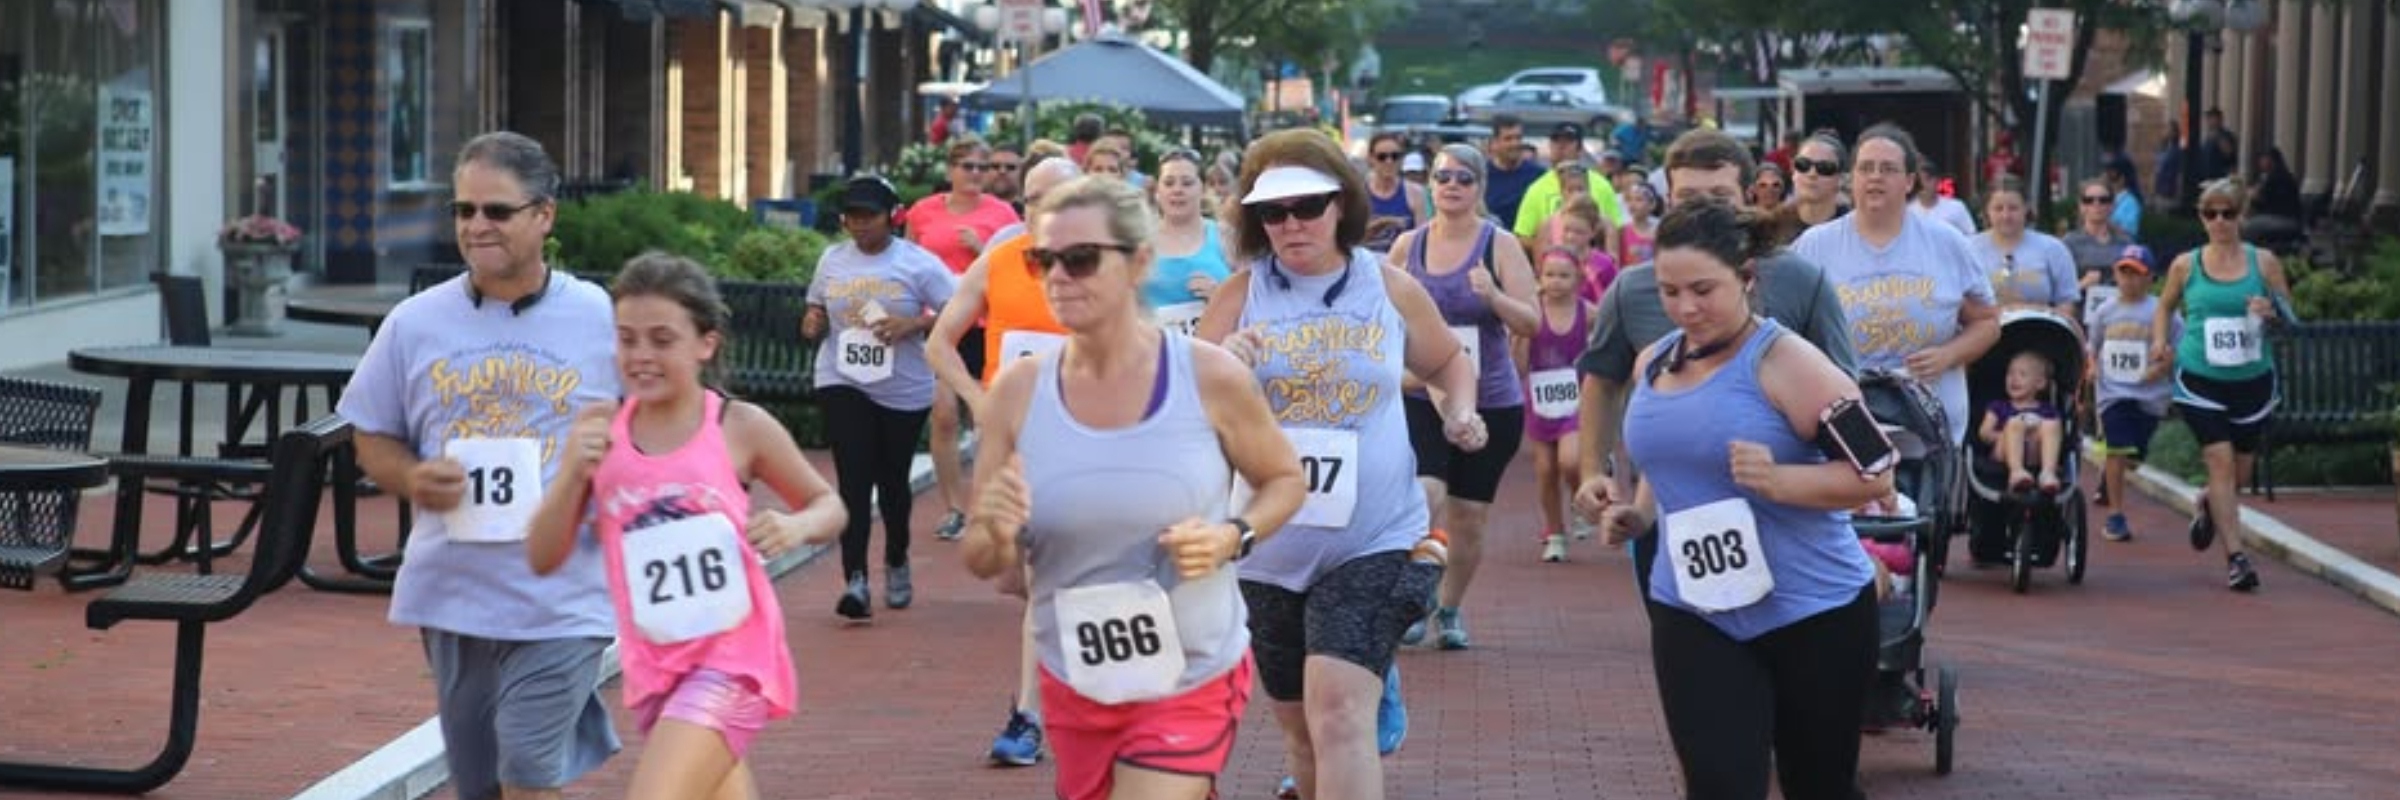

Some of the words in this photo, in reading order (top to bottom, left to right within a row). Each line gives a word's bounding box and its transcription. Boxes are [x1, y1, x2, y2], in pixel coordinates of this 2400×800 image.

[846, 343, 885, 368] 530
[1535, 382, 1577, 403] 1098
[468, 466, 515, 505] 13
[1301, 456, 1343, 494] 07
[1682, 528, 1748, 580] 303
[645, 547, 728, 605] 216
[1076, 613, 1162, 667] 966
